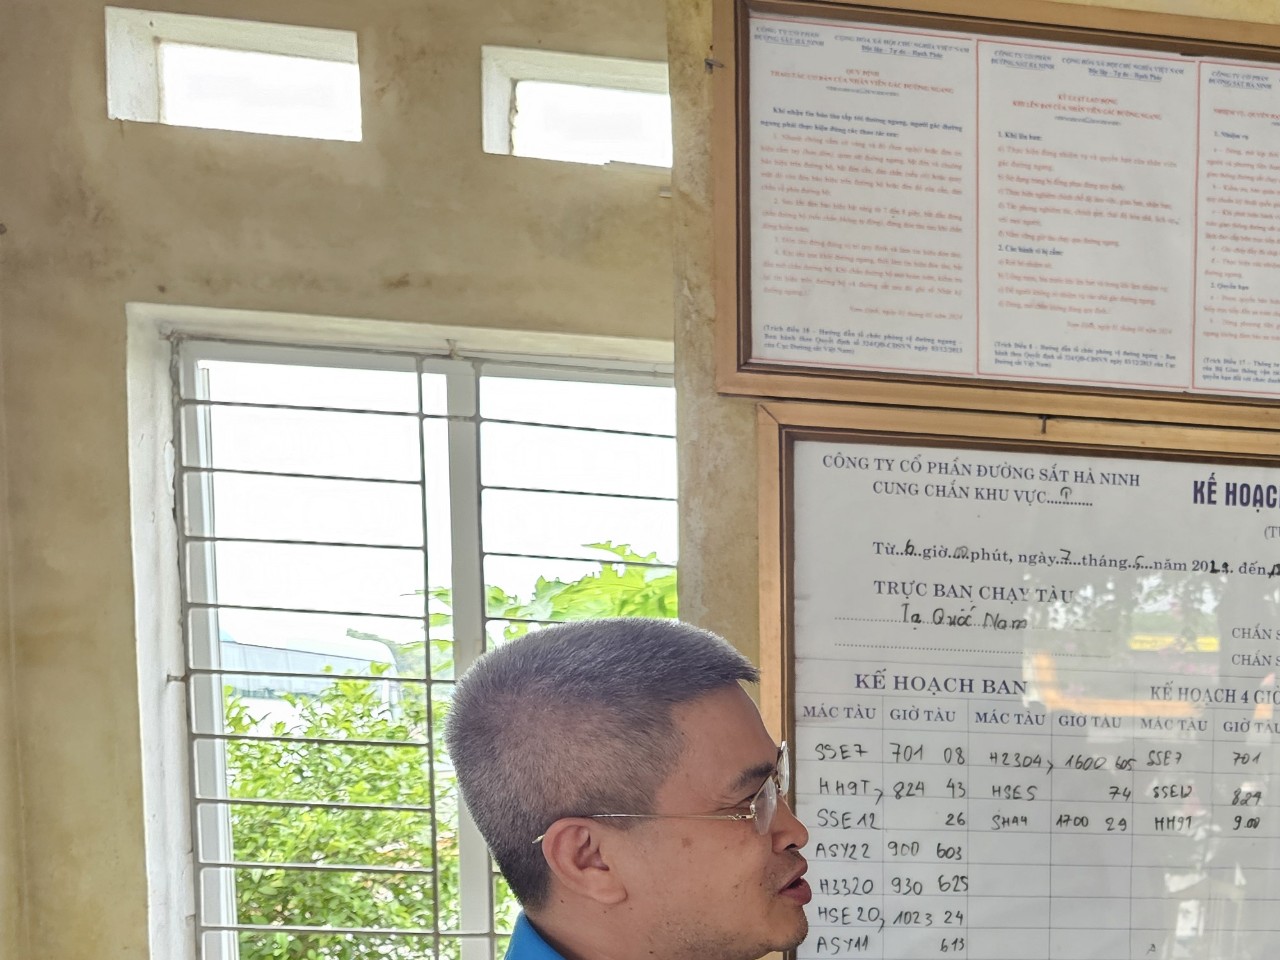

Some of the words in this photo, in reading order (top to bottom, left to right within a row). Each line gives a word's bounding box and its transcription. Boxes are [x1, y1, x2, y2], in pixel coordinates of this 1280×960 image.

[822, 452, 869, 470] CÔNG
[874, 458, 895, 471] TY
[900, 454, 922, 473] CỔ
[977, 461, 1034, 480] ĐƯỜNG
[1039, 464, 1069, 482] SẮT
[1074, 468, 1095, 484] HÀ
[1100, 472, 1140, 487] NINH
[873, 481, 919, 496] CUNG
[975, 487, 1009, 502] KHU
[1193, 472, 1217, 506] KẾ
[874, 580, 927, 599] TRỰC
[933, 583, 972, 598] BAN
[979, 586, 1028, 604] CHẠY
[1035, 586, 1074, 603] TÀU
[855, 668, 887, 689] KẾ
[893, 675, 974, 695] HOẠCH
[982, 679, 1028, 694] BAN
[1150, 680, 1173, 700] KẾ
[1178, 687, 1236, 706] HOẠCH
[1241, 690, 1249, 704] 4
[803, 705, 841, 719] MÁC
[843, 706, 877, 720] TÀU
[889, 706, 920, 722] GIỜ
[923, 708, 956, 723] TÀU
[975, 710, 1011, 725] MÁC
[1014, 712, 1046, 727] TÀU
